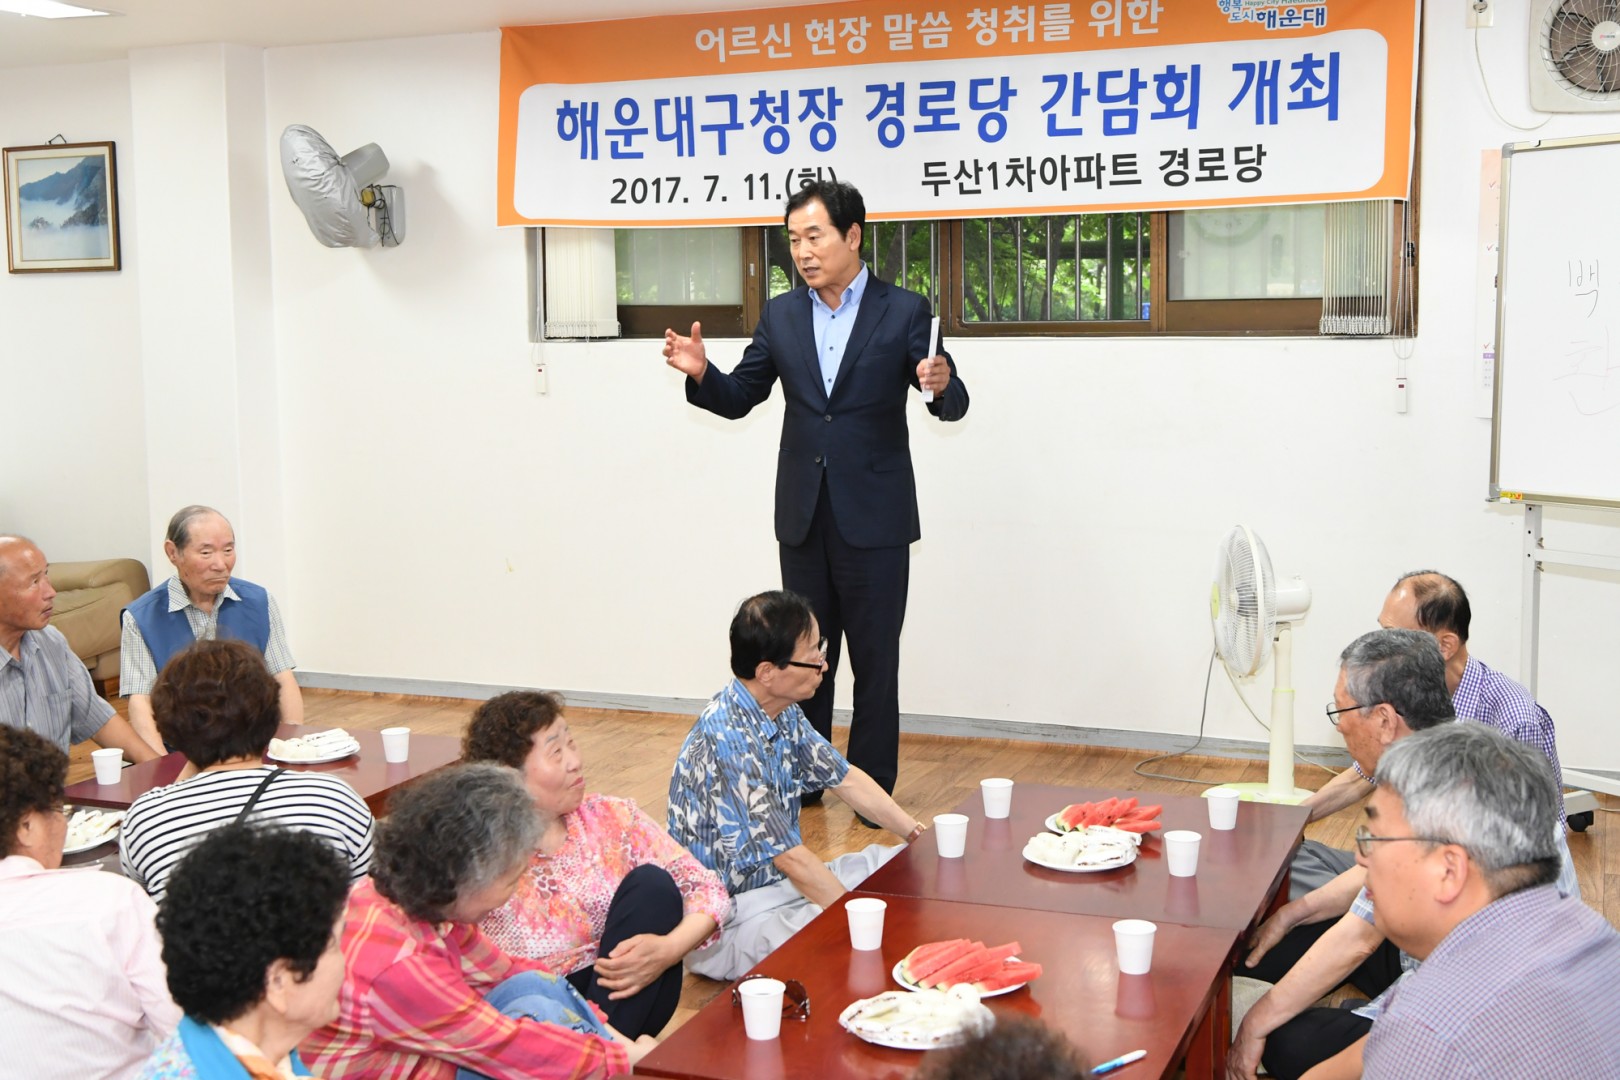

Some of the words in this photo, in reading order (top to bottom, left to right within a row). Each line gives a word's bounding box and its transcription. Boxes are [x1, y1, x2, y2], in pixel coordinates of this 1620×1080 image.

[695, 23, 792, 63] 어르신
[805, 16, 871, 55] 현장
[884, 11, 952, 50] 말씀
[967, 3, 1074, 46] 청취를
[1088, 0, 1164, 37] 위한
[1230, 9, 1254, 22] 도시
[1256, 7, 1325, 28] 해운대
[556, 86, 843, 160] 해운대구청장
[866, 76, 1017, 149] 경로당
[1040, 63, 1201, 137] 간담회
[1228, 51, 1340, 126] 개최
[610, 176, 689, 204] 2017.
[703, 175, 727, 202] 7.
[921, 152, 1142, 196] 두산1차아파트
[1158, 143, 1267, 187] 경로당
